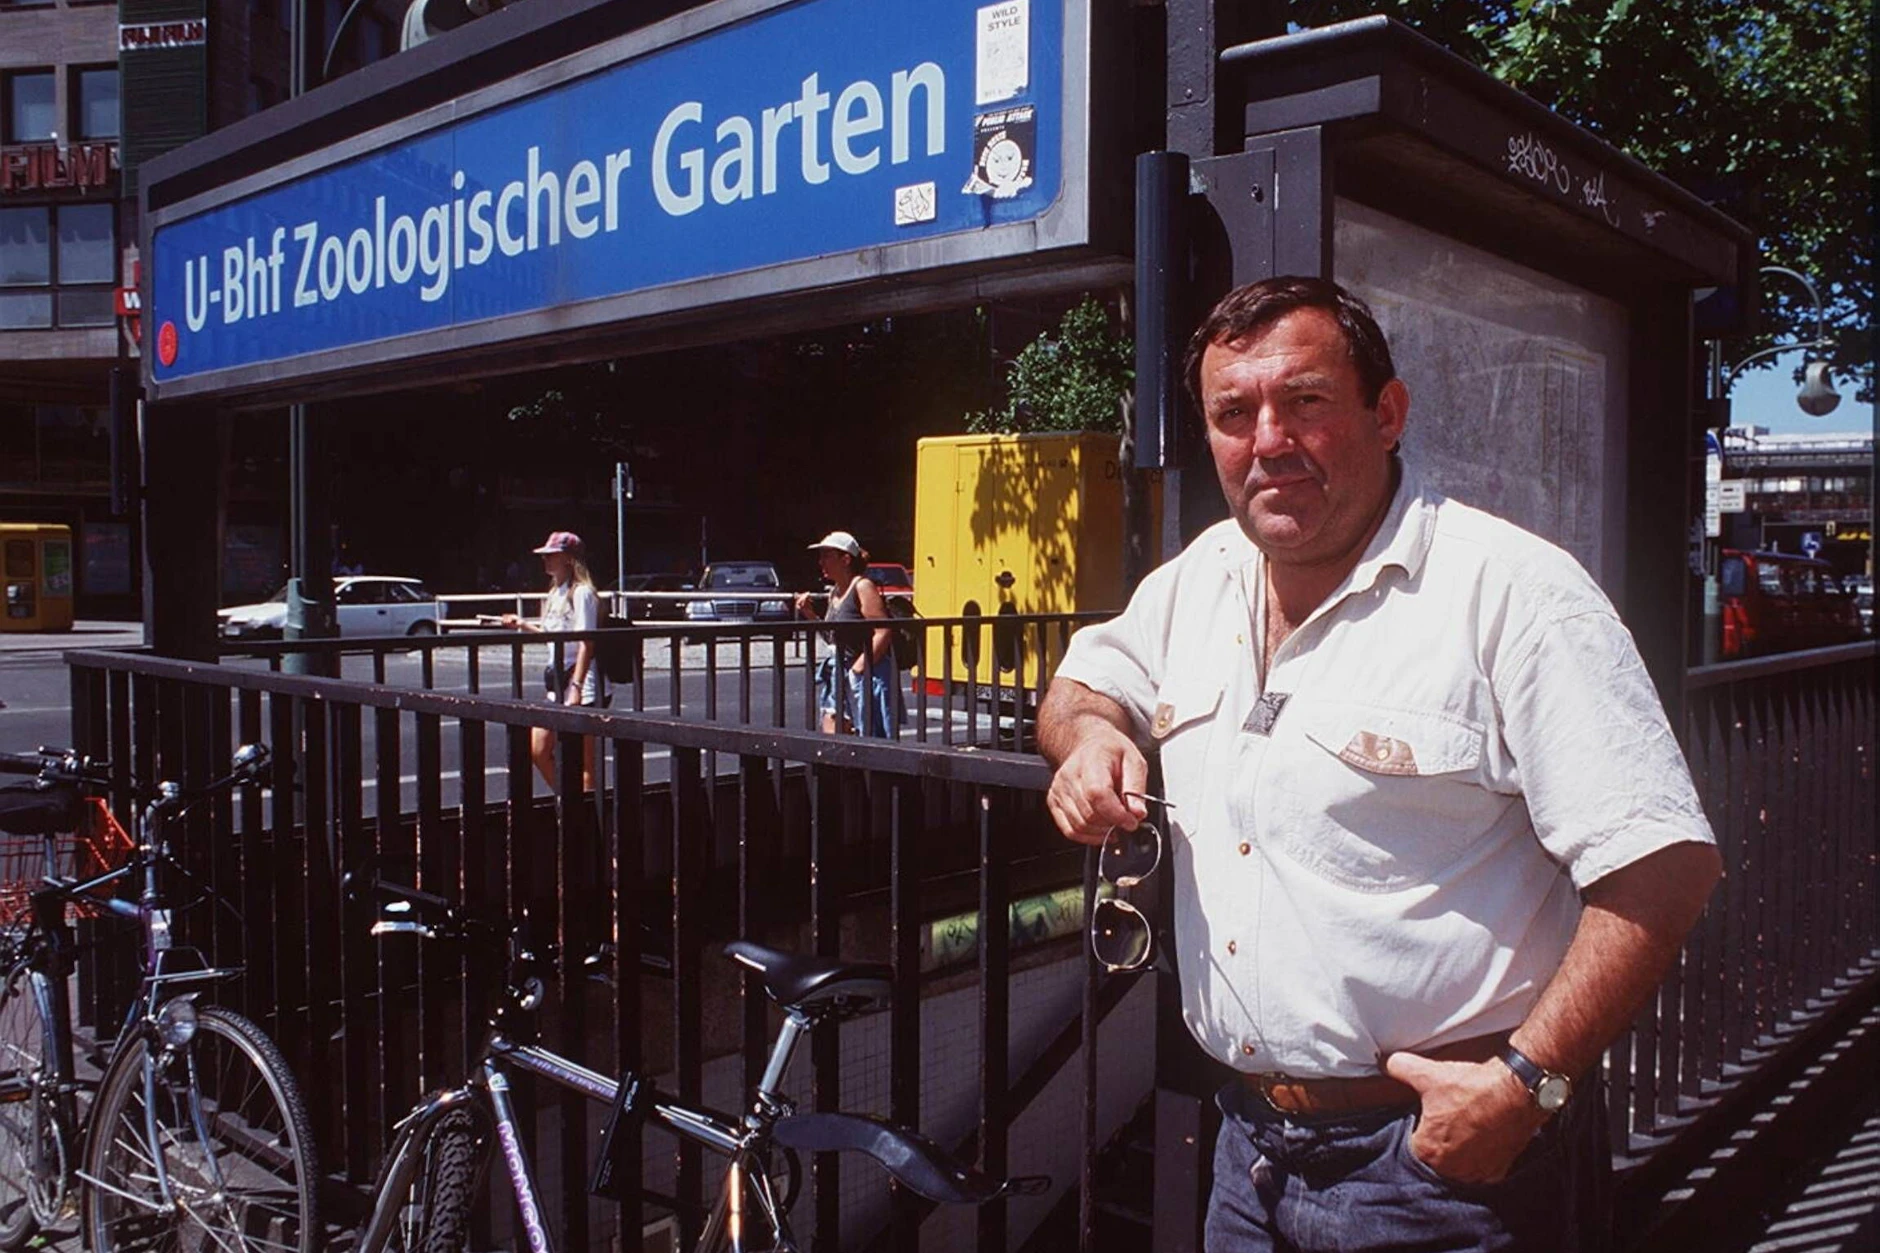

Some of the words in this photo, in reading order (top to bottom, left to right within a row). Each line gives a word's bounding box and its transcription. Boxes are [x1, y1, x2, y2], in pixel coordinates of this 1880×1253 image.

[987, 16, 1021, 32] STYLE
[992, 6, 1018, 19] WILD
[1, 144, 107, 191] FILM
[185, 227, 284, 333] U-Bhf
[293, 146, 632, 302] Zoologischer
[651, 61, 945, 217] Garten
[497, 1120, 547, 1253] MONGO
